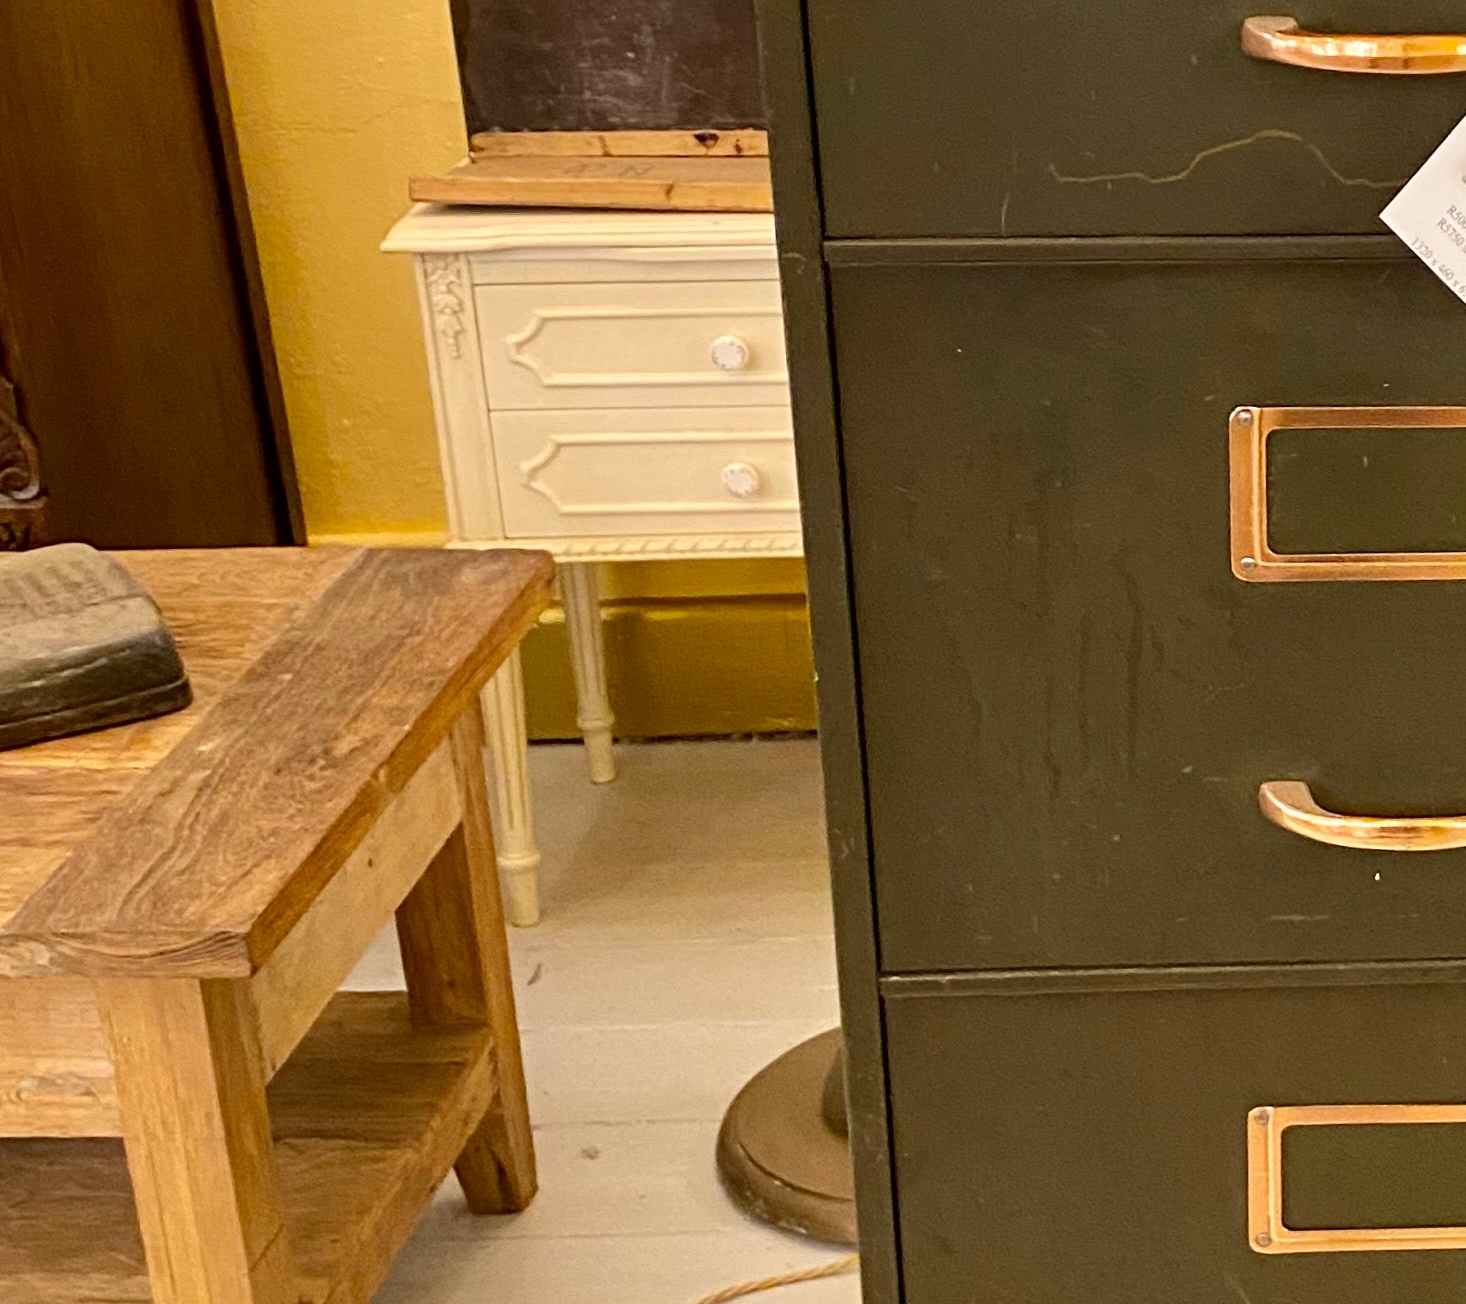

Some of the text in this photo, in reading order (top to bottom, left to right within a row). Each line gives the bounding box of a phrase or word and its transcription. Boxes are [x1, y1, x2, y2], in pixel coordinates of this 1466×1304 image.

[1436, 218, 1465, 247] R5750
[1411, 238, 1433, 260] 1320
[1430, 259, 1438, 267] x
[1437, 264, 1455, 282] 460
[1452, 280, 1459, 288] x
